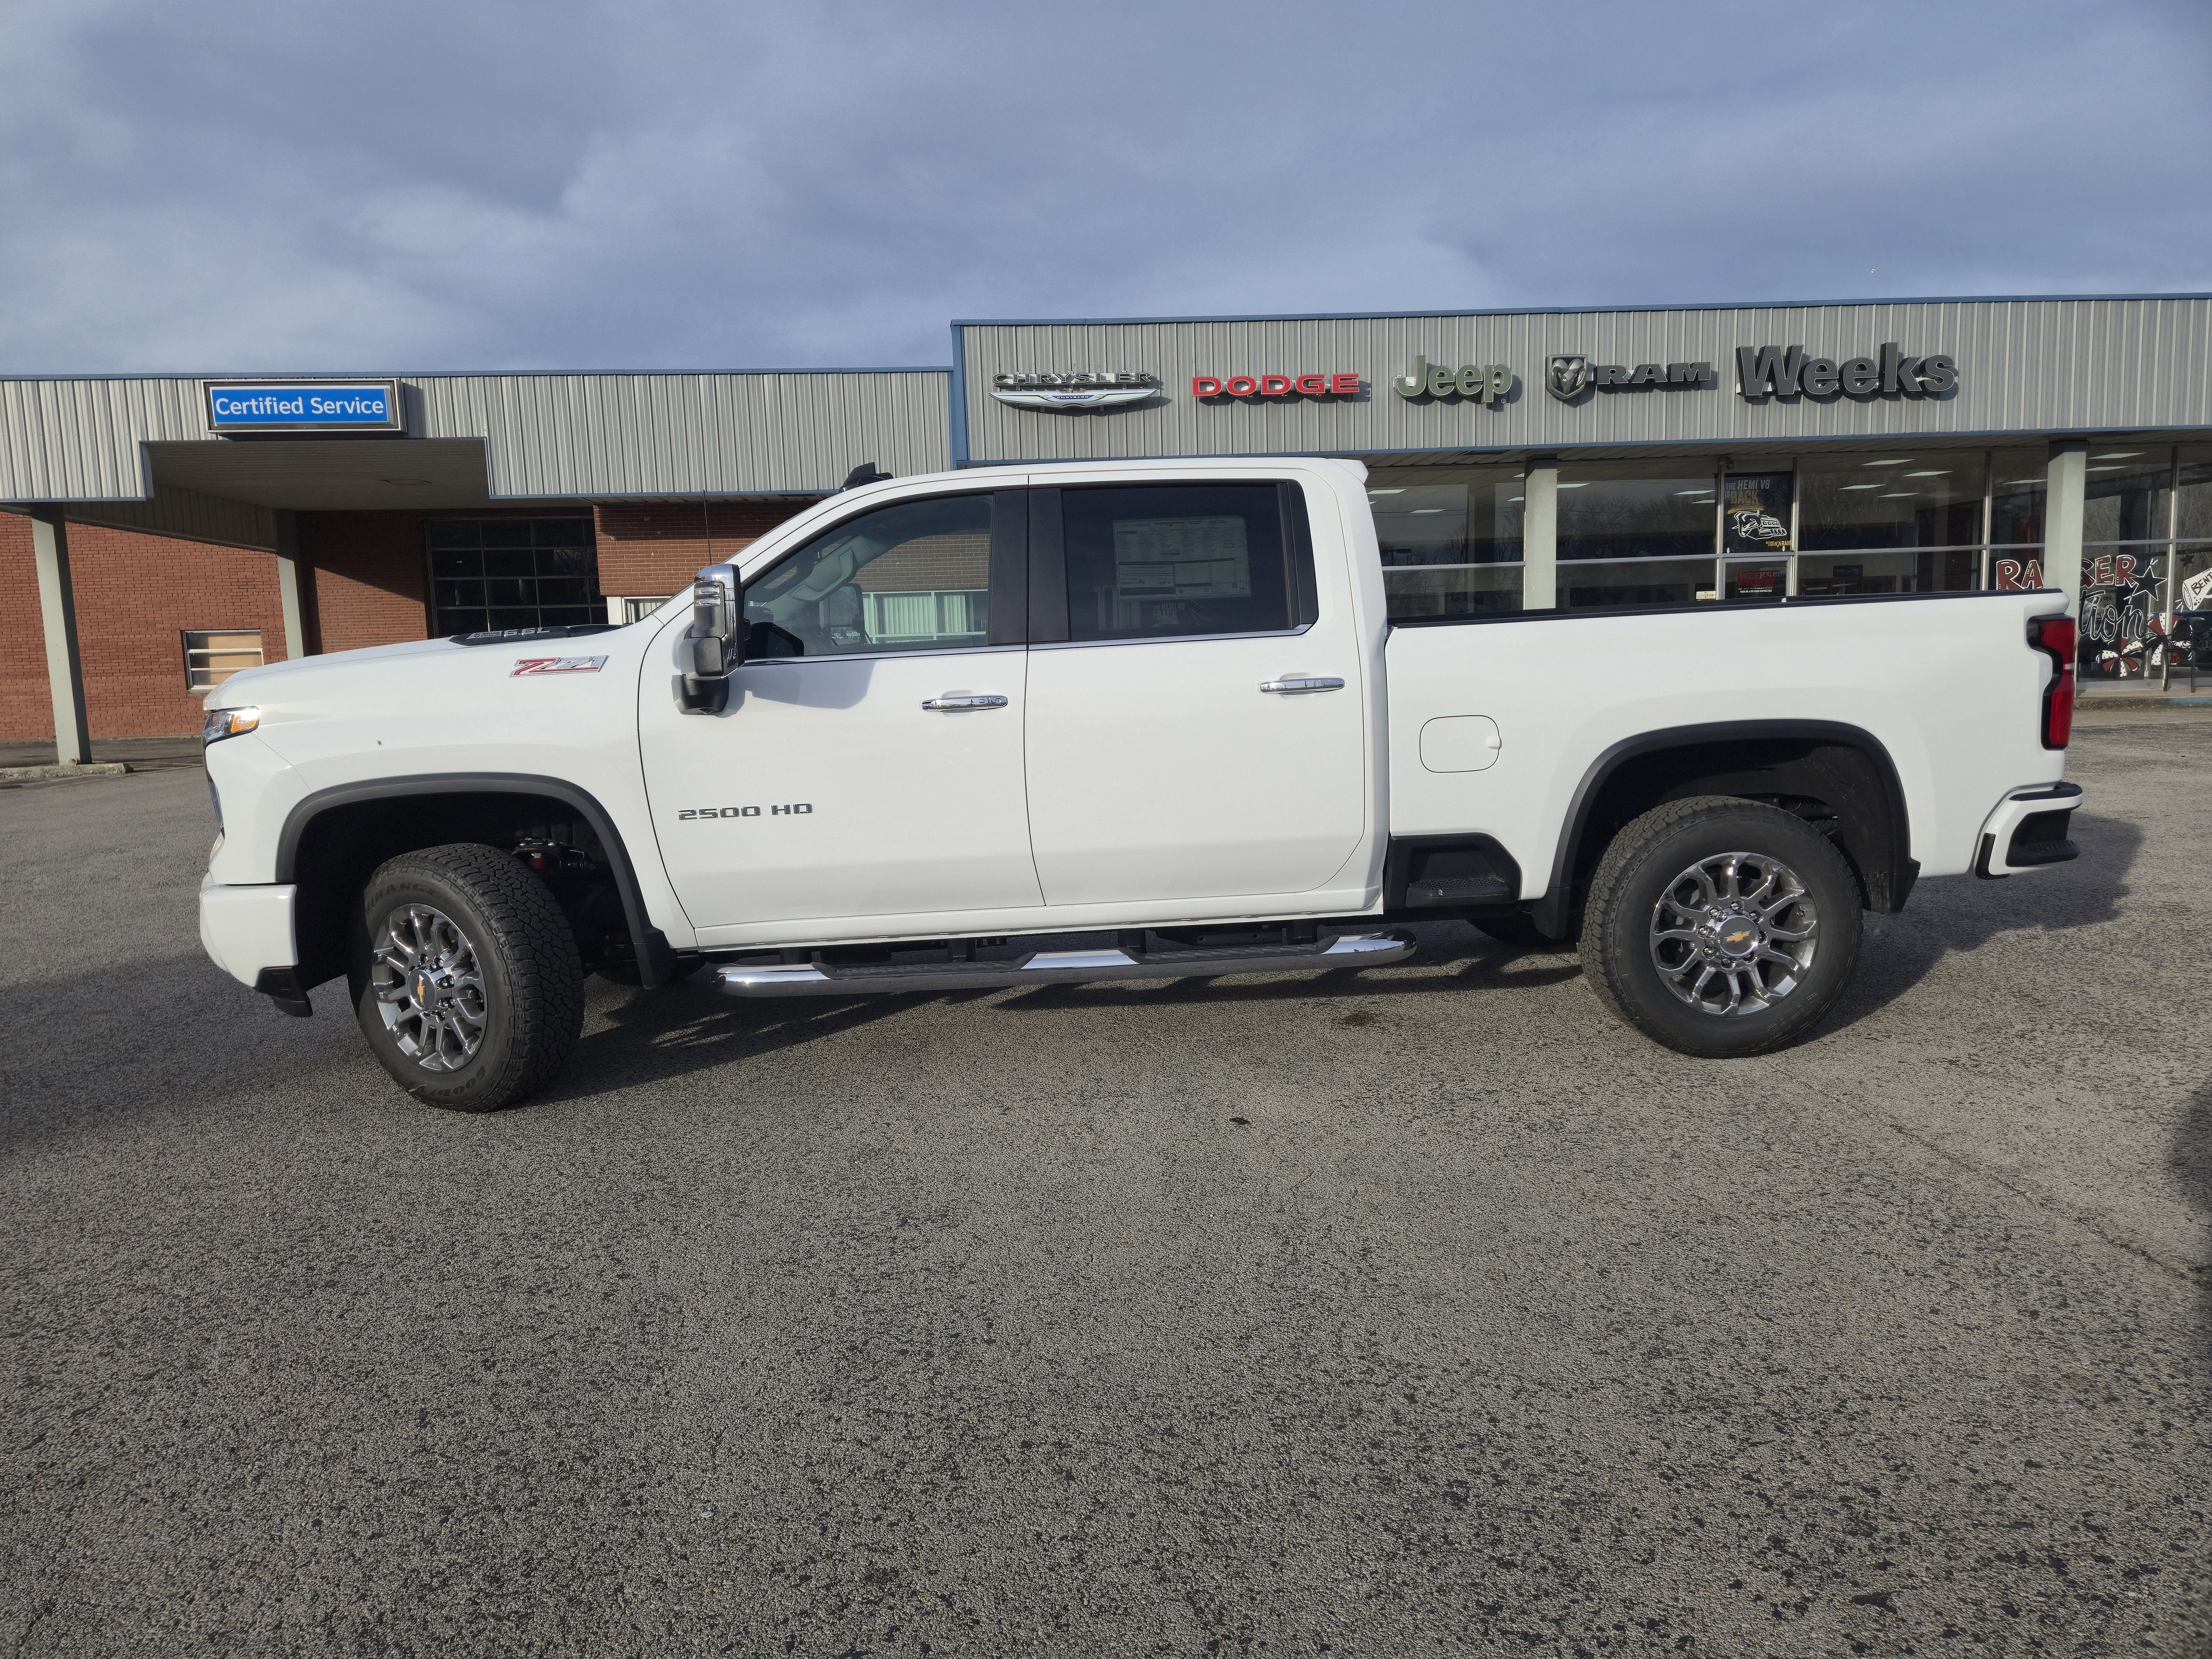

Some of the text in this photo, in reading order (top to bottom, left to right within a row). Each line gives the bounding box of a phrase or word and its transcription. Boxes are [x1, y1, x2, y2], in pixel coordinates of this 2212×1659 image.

[1596, 361, 1712, 384] RAM
[1737, 342, 1955, 395] Weeks
[992, 372, 1151, 384] CHRYSLER
[1192, 373, 1359, 397] DODGE
[1395, 355, 1512, 403] Jeep
[215, 397, 384, 415] Certified Service
[1737, 479, 1758, 490] HEMI
[1761, 479, 1770, 489] V8
[1730, 490, 1759, 505] BACK
[1157, 610, 1177, 620] BACK
[504, 628, 550, 637] 6.6L
[509, 655, 609, 677] Z71
[678, 803, 813, 820] 2500 HD
